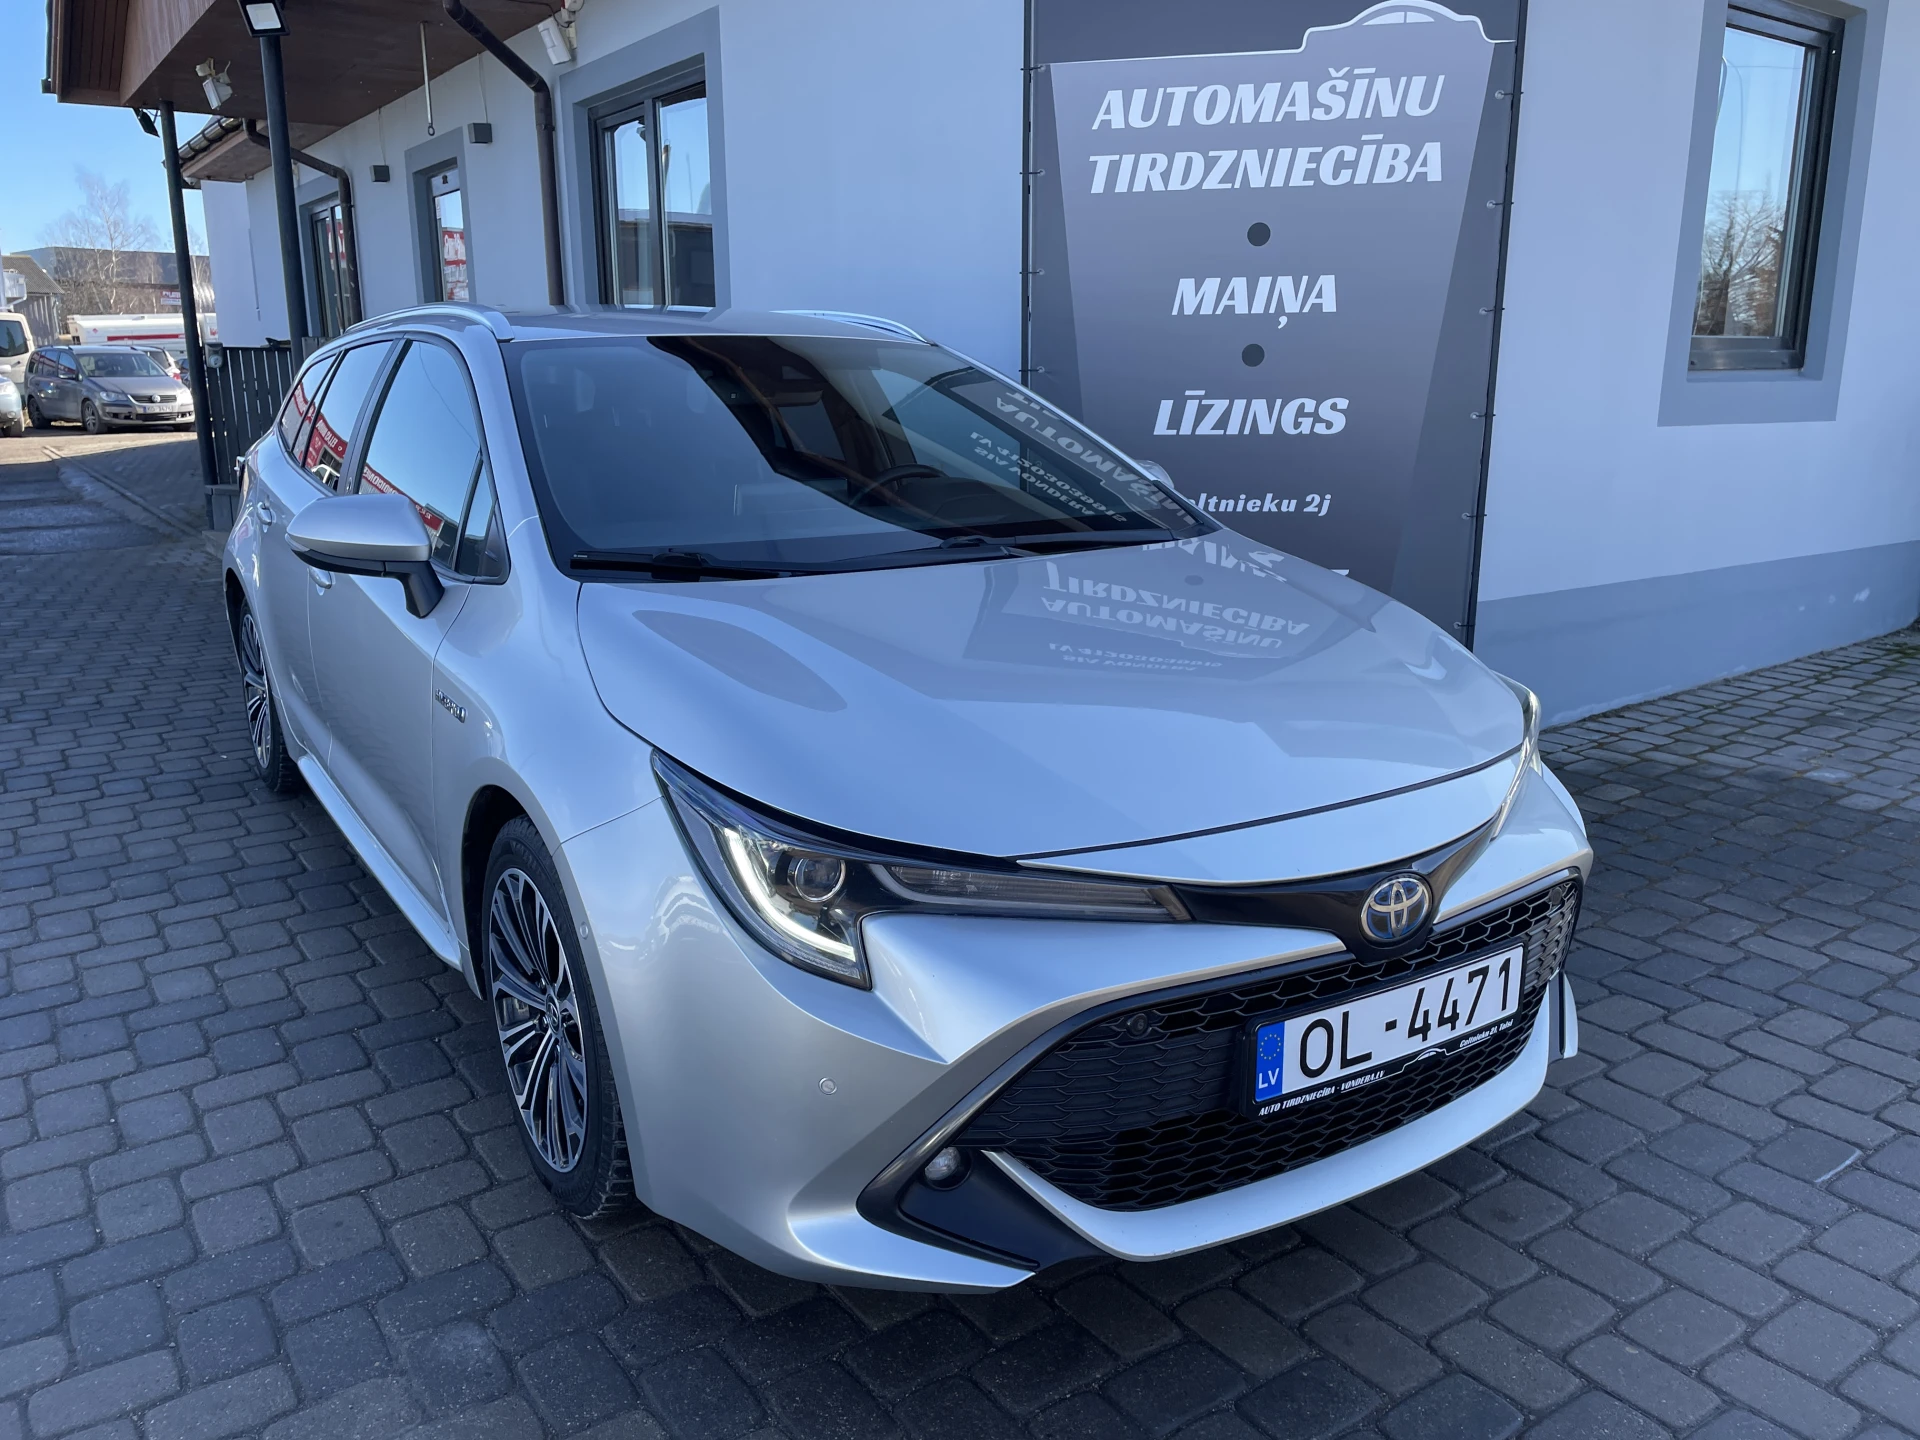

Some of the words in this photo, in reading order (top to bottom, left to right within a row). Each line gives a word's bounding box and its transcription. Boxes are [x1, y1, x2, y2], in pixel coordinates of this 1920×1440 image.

[1092, 66, 1445, 130] AUTOMAŠĪNU
[1089, 133, 1442, 194] TIRDZNIECĪBA
[1171, 274, 1338, 330] MAIŅA
[1153, 390, 1350, 436] LĪZINGS
[1188, 492, 1298, 513] ltnieku
[1303, 493, 1332, 517] 2j
[1258, 1068, 1280, 1089] LV
[1258, 1102, 1281, 1116] AUTO
